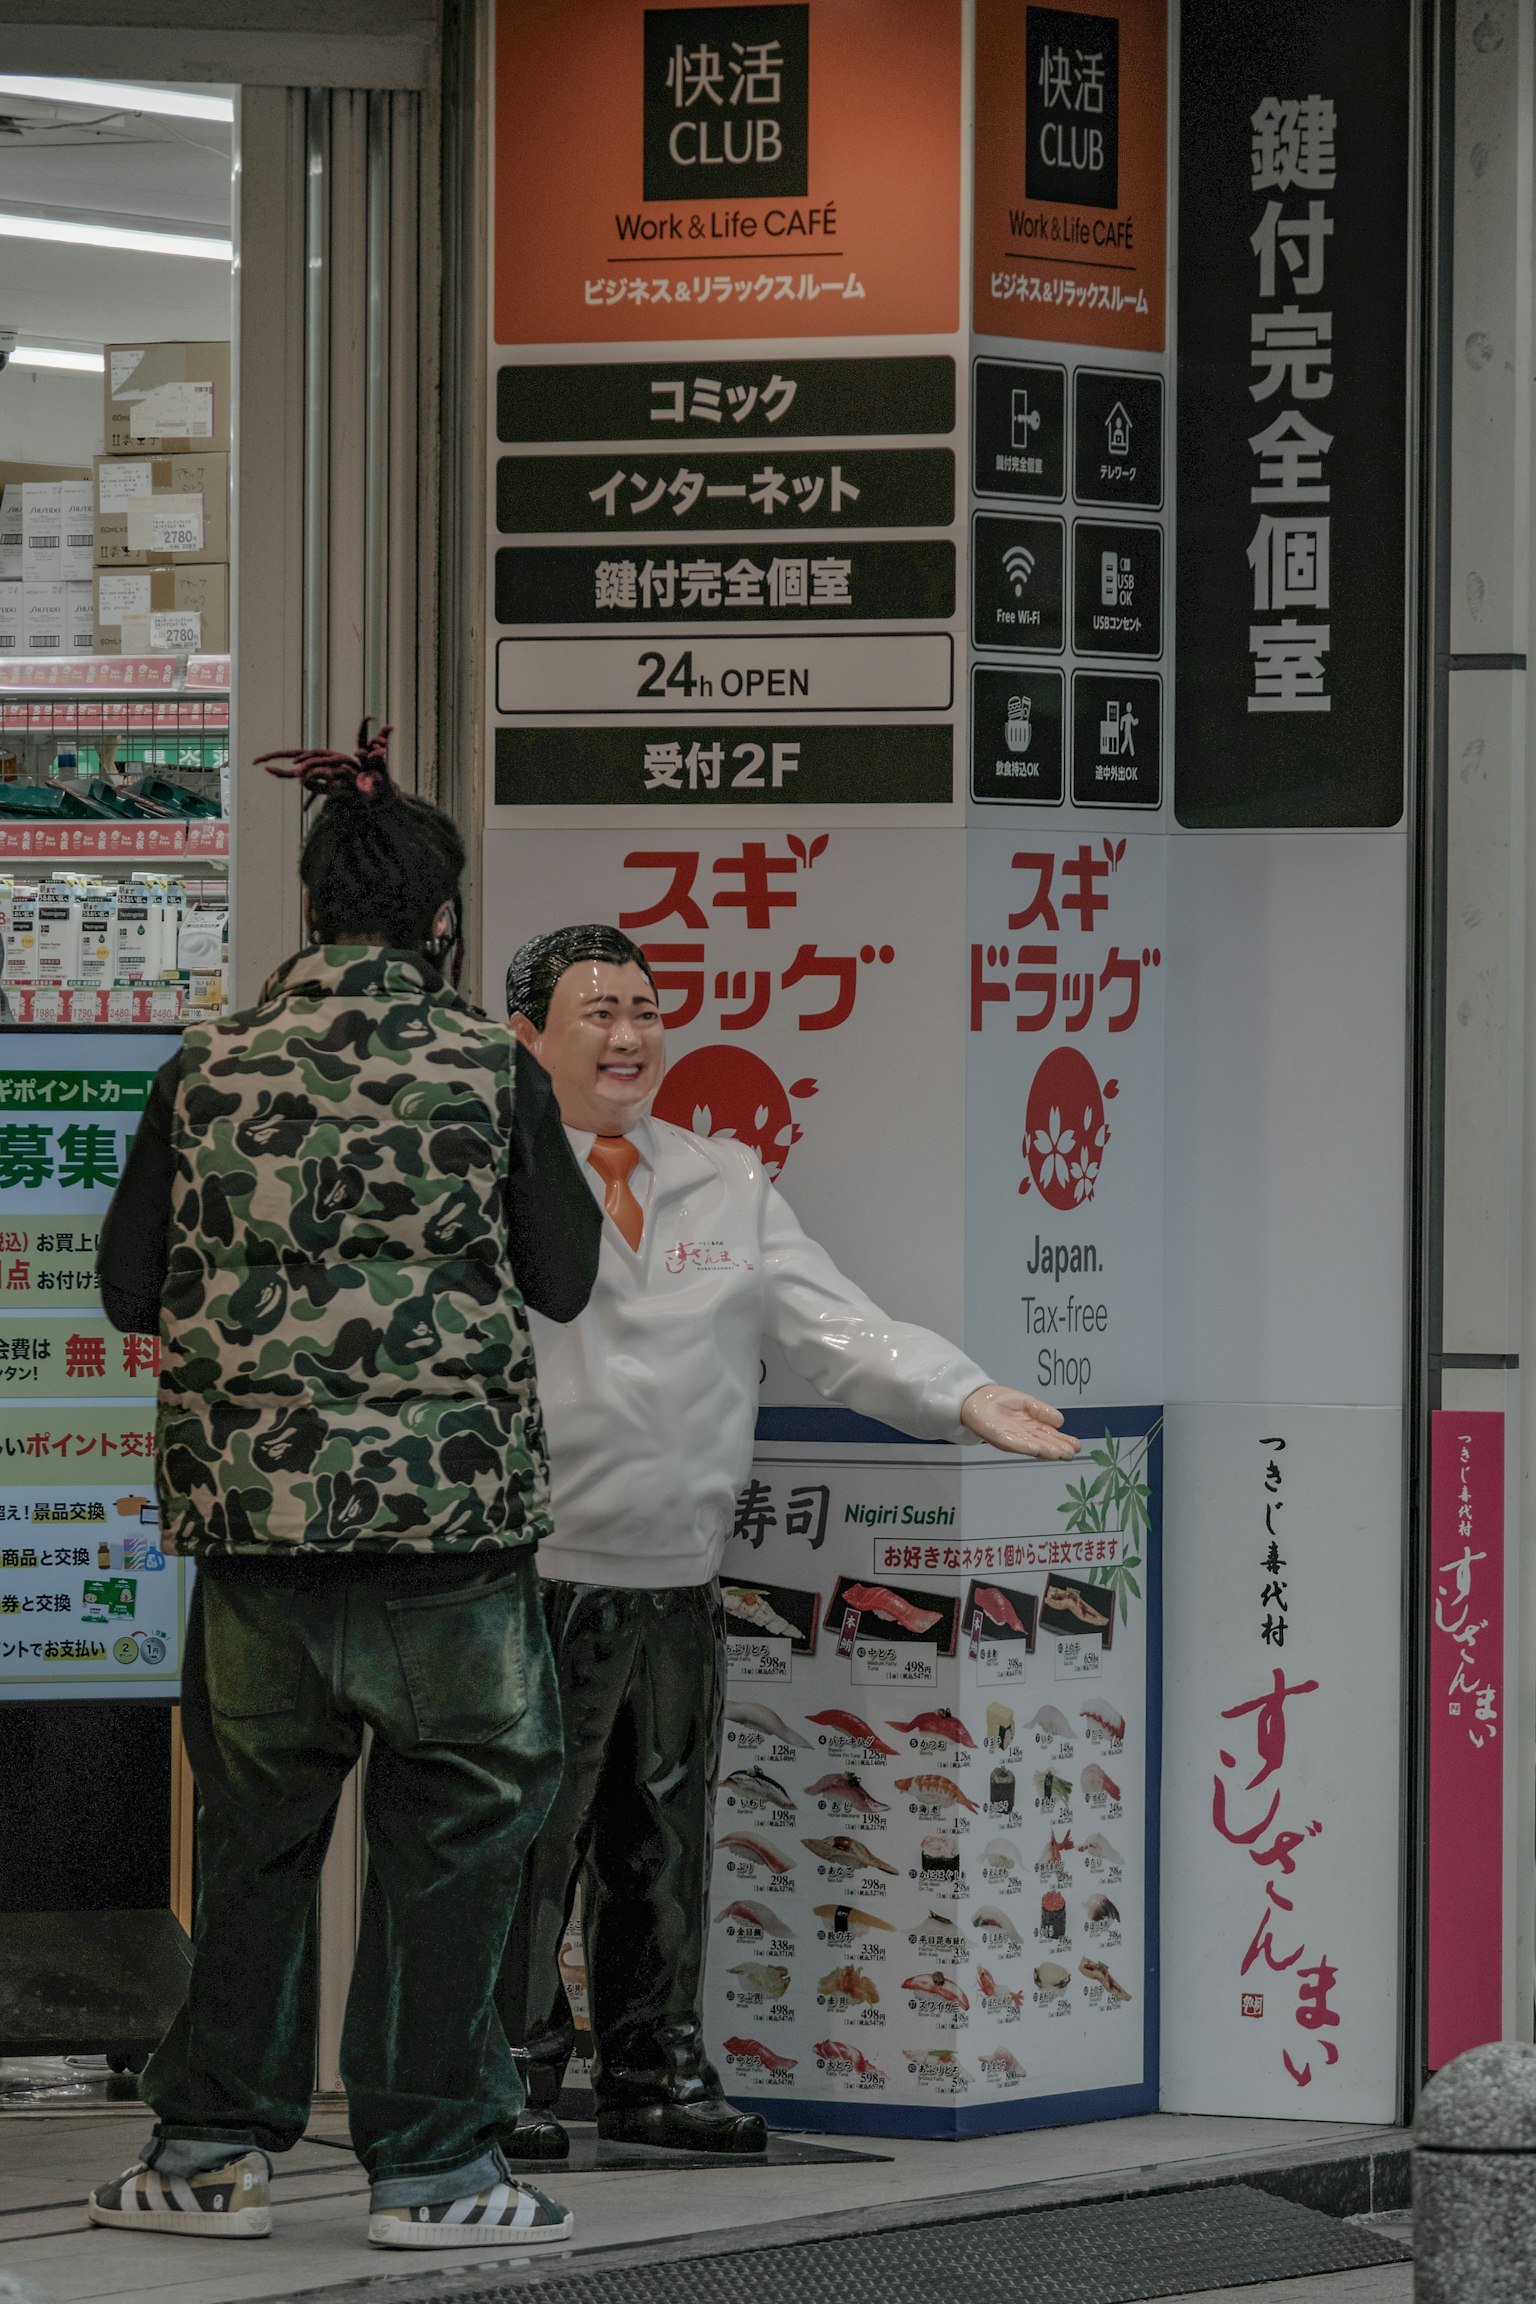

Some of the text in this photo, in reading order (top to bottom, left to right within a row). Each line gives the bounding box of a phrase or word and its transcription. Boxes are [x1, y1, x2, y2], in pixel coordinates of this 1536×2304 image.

[665, 40, 784, 109] 快活
[1038, 45, 1105, 114] 快活
[669, 119, 783, 166] CLUB
[1039, 122, 1104, 171] CLUB
[615, 201, 836, 241] Work & Life CAFÉ
[1010, 211, 1048, 240] Work
[1063, 216, 1090, 244] Life
[1093, 216, 1133, 249] CAFÉ
[584, 272, 865, 307] ビジネス&リラックスルーム
[990, 272, 1148, 314] ビジネス&リラックスルーム
[650, 375, 797, 424] コミック
[1247, 94, 1337, 712] 鍵付完全個室
[1100, 465, 1136, 481] テレワーク
[588, 466, 860, 517] インターネット
[29, 506, 61, 514] SHISEIDO
[594, 556, 853, 609] 鍵付完全個室
[1118, 574, 1134, 590] USB
[29, 606, 61, 614] SHISEIDO
[1119, 590, 1132, 606] OK
[997, 608, 1040, 625] Free Wi-Fi
[1093, 615, 1142, 632] USBコンセント
[637, 651, 809, 698] 24h OPEN
[643, 742, 801, 790] 受付2F
[995, 760, 1040, 777] 飲食持込OK
[1095, 765, 1138, 781] 途中外出OK
[618, 833, 829, 929] スギ
[1008, 837, 1127, 931] スギ
[970, 943, 1161, 1032] ドラッグ
[0, 1078, 153, 1104] ギポイントカー
[0, 1123, 135, 1189] 募集
[1026, 1234, 1103, 1283] Japan.
[1021, 1295, 1108, 1334] Tax-free
[65, 1333, 162, 1378] 無料
[1037, 1348, 1091, 1395] Shop
[1457, 1435, 1473, 1538] つきじ喜代村
[845, 1503, 898, 1527] Nigiri
[901, 1505, 955, 1525] Sushi
[1259, 1435, 1289, 1647] つきじ喜代村
[2, 1548, 90, 1568] 商品と交換
[2, 1593, 71, 1613] 券と交換
[122, 1643, 129, 1653] 2
[868, 1648, 897, 1660] 中とろ
[1435, 1546, 1498, 1749] すしざんまい
[759, 1656, 786, 1669] 598円
[904, 1661, 931, 1674] 498円
[772, 1745, 796, 1756] 128円
[863, 1749, 886, 1760] 128円
[772, 1810, 796, 1821] 198円
[863, 1814, 886, 1825] 198円
[771, 1875, 794, 1887] 298円
[861, 1879, 886, 1890] 298円
[1212, 1667, 1341, 2087] すしざんまい
[770, 1940, 794, 1951] 338円
[861, 1944, 886, 1955] 338円
[770, 2004, 794, 2016] 498円
[861, 2009, 886, 2020] 498円
[770, 2069, 794, 2080] 498円
[860, 2073, 885, 2084] 598円
